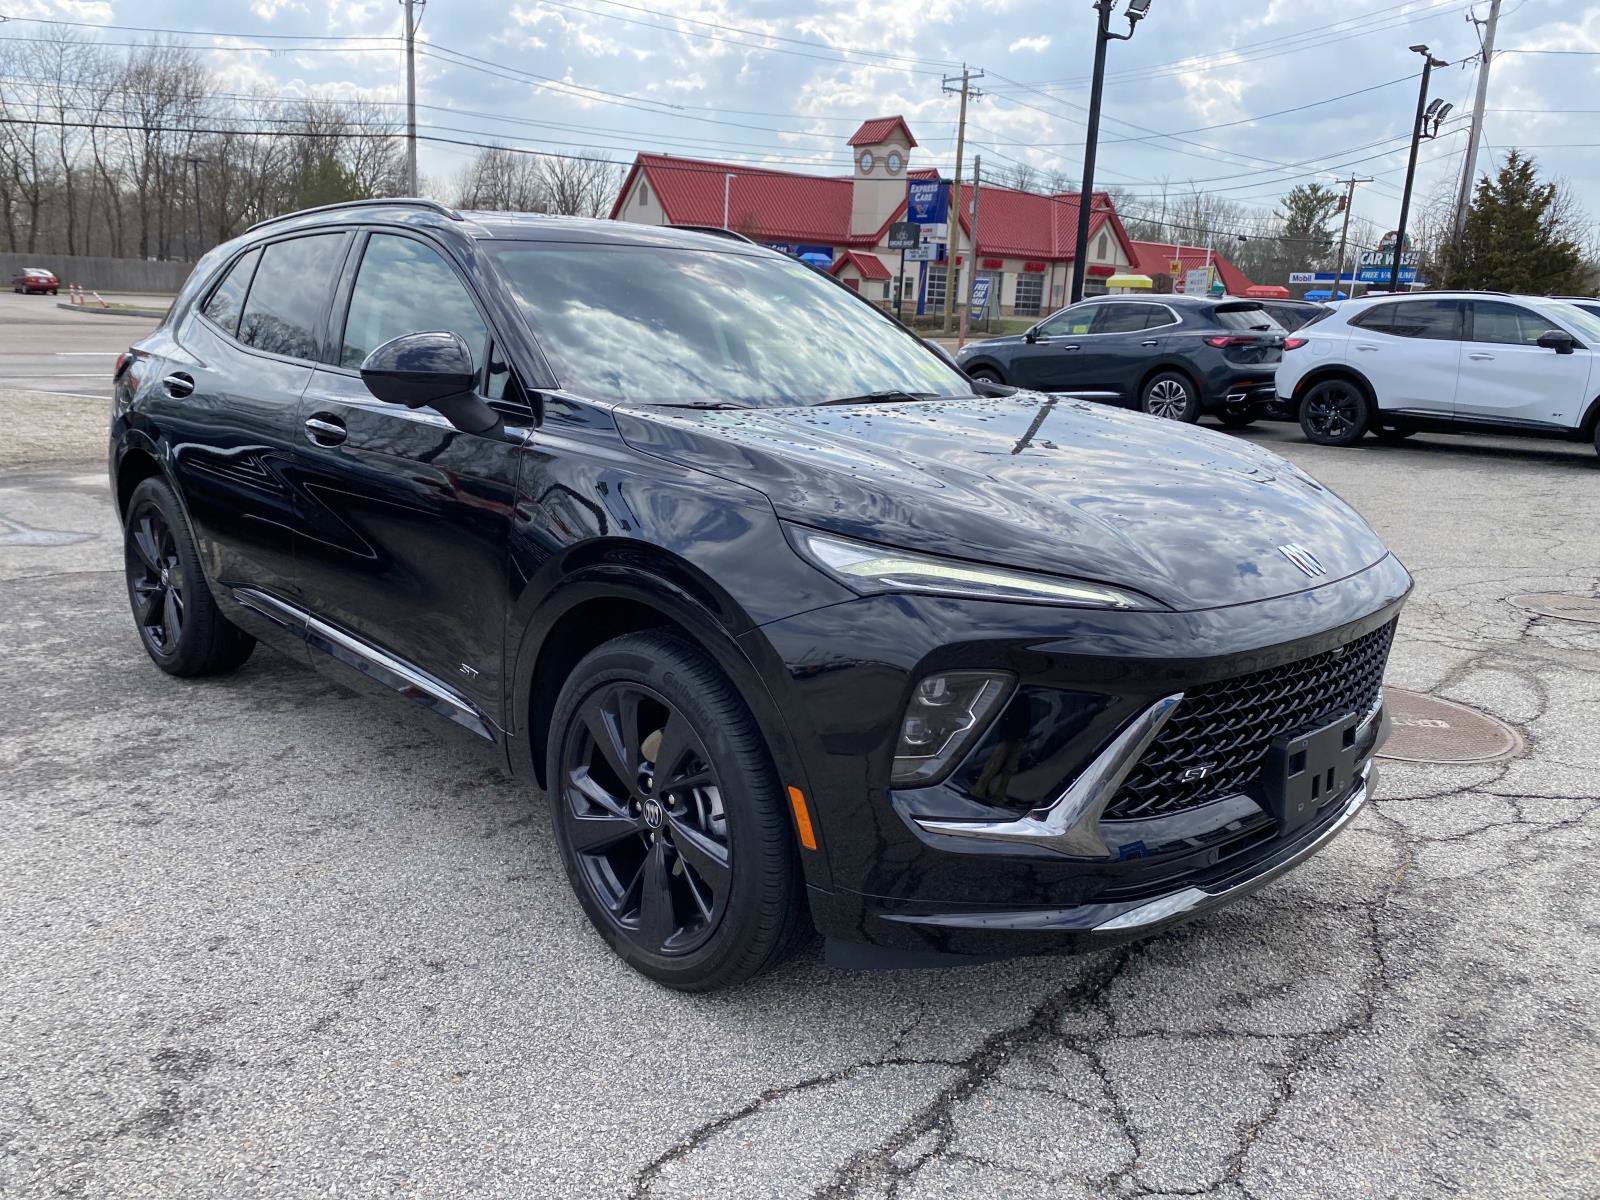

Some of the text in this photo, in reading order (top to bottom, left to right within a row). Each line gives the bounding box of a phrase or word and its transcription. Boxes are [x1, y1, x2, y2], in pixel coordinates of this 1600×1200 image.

[910, 184, 938, 193] EXPRESS
[914, 193, 932, 202] CARE
[1360, 252, 1383, 265] CAR
[1292, 274, 1312, 282] Mobil
[1361, 271, 1379, 279] FREE
[972, 290, 986, 298] CAR
[459, 663, 479, 679] ST
